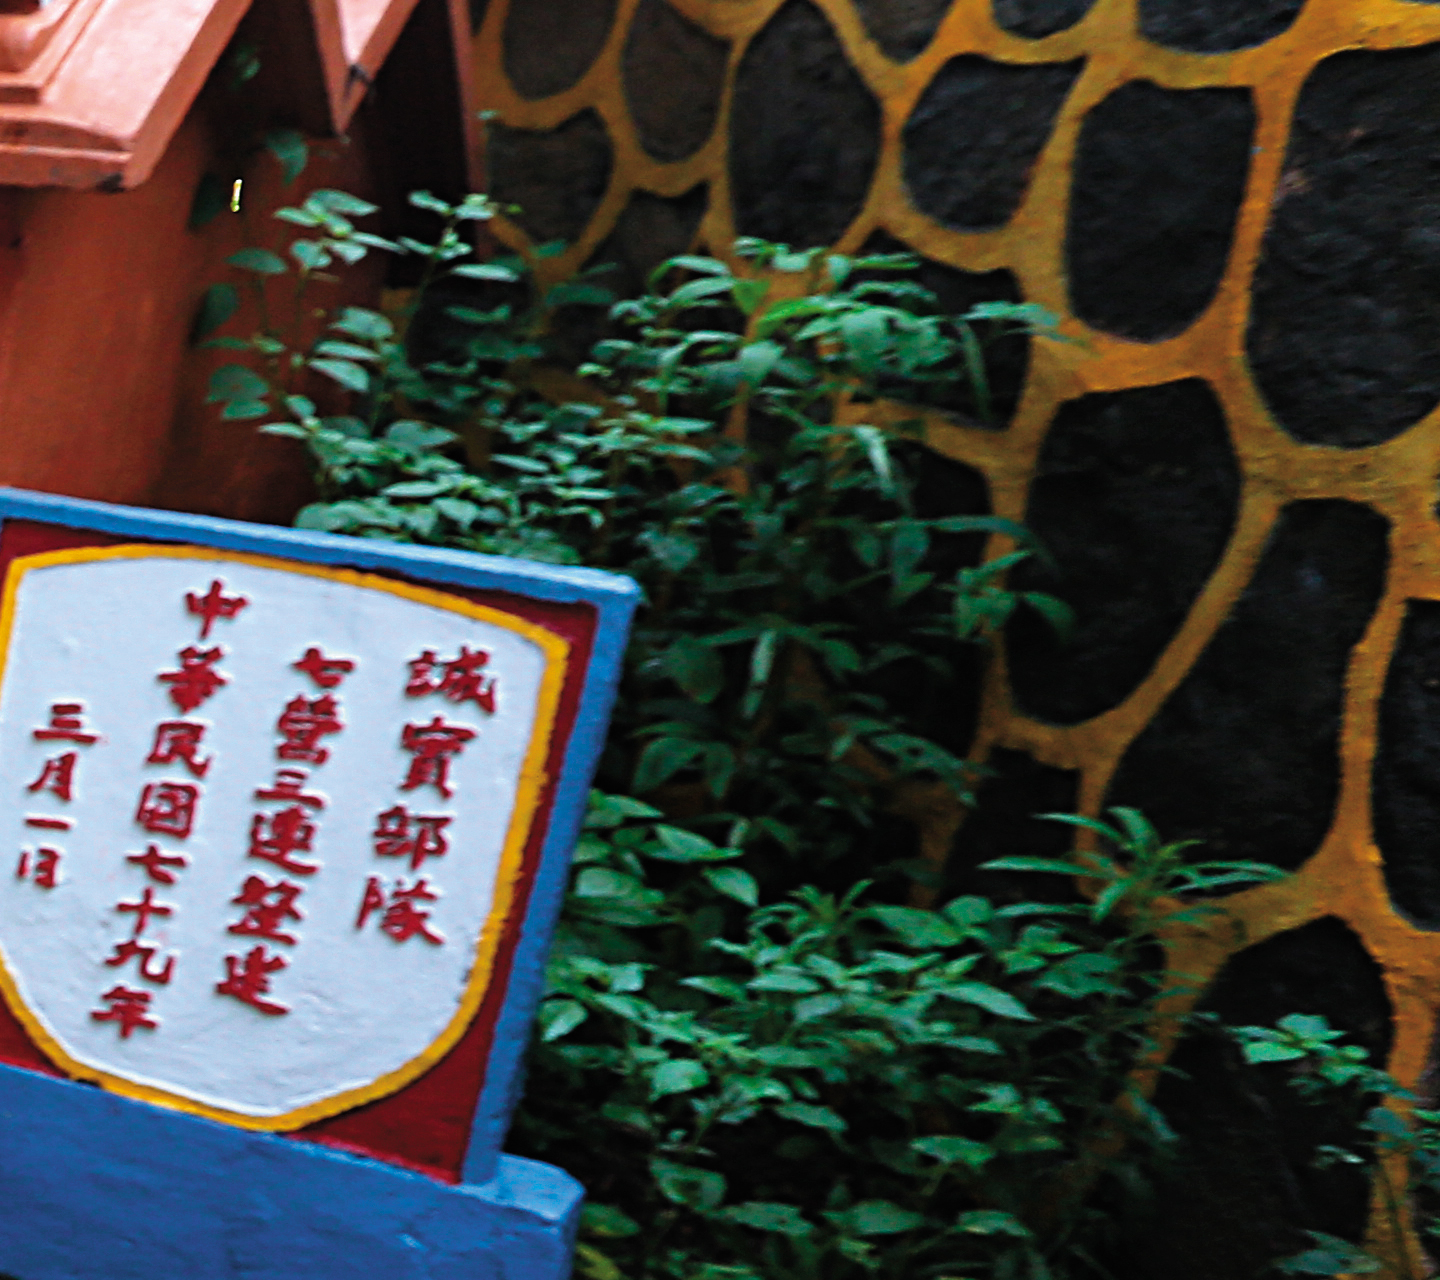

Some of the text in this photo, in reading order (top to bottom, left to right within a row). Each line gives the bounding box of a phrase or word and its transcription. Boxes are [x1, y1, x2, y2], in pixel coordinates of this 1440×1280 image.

[17, 704, 97, 888] 三月一日
[91, 580, 248, 1038] 中華民國七十九年
[356, 646, 497, 946] 誠實部隊
